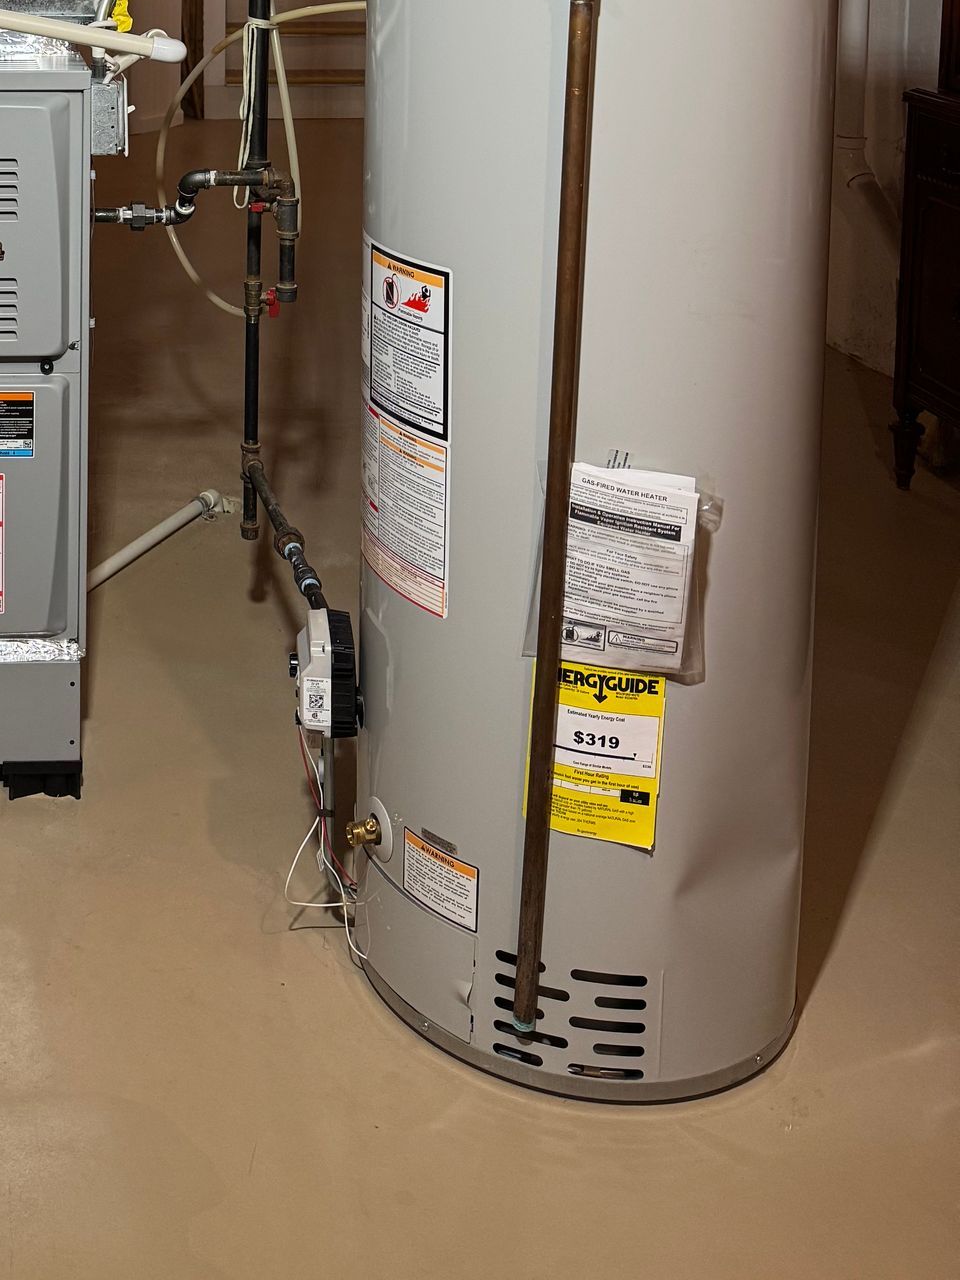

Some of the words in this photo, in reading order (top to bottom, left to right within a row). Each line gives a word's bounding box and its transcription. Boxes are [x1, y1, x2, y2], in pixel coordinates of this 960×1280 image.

[393, 265, 415, 278] WARNING
[582, 478, 615, 491] GAS-FIRED
[616, 486, 640, 497] WATER
[641, 492, 668, 502] HEATER
[558, 668, 660, 696] ERGYGUIDE
[568, 709, 587, 718] Estimated
[588, 712, 600, 720] Yearly
[573, 730, 620, 750] $319
[595, 772, 610, 780] Rating
[425, 846, 455, 868] WARNING
